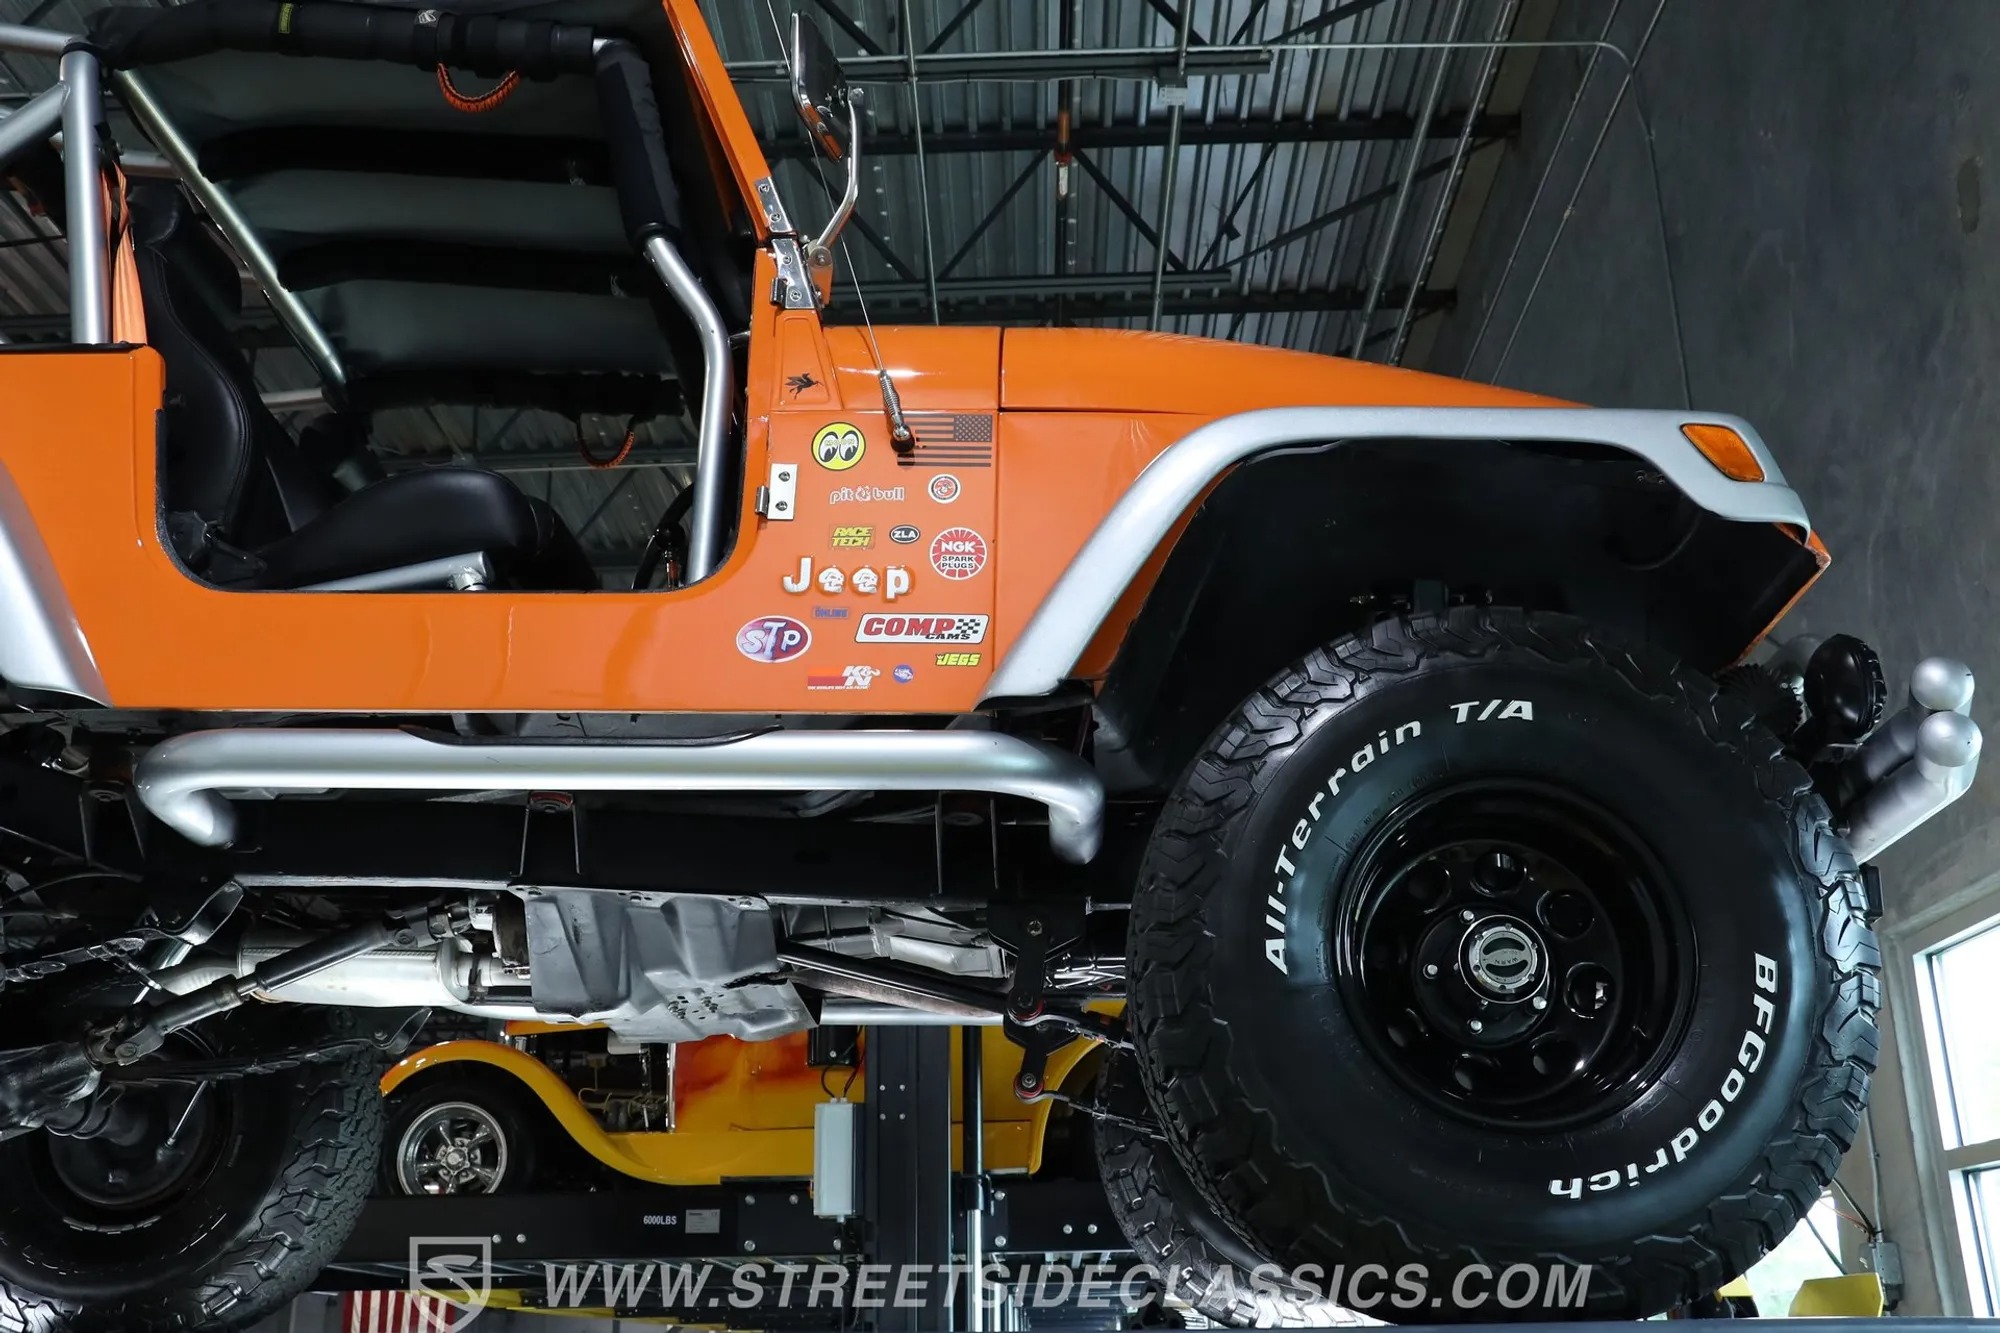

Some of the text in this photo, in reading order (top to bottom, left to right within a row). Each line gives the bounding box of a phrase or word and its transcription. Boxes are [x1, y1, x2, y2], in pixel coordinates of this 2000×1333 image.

[873, 487, 904, 501] bull
[834, 527, 872, 536] RACE
[893, 530, 916, 538] ZLA
[832, 537, 870, 547] TECH
[941, 541, 975, 553] NGK
[782, 556, 911, 600] Jeep
[863, 617, 956, 636] COMP
[742, 621, 801, 658] STP
[936, 653, 981, 666] JEGS
[1264, 719, 1422, 977] All-Terrain
[1450, 699, 1534, 725] T/A
[1548, 951, 1779, 1200] BFGoodrich
[643, 1215, 677, 1225] 6000LBS
